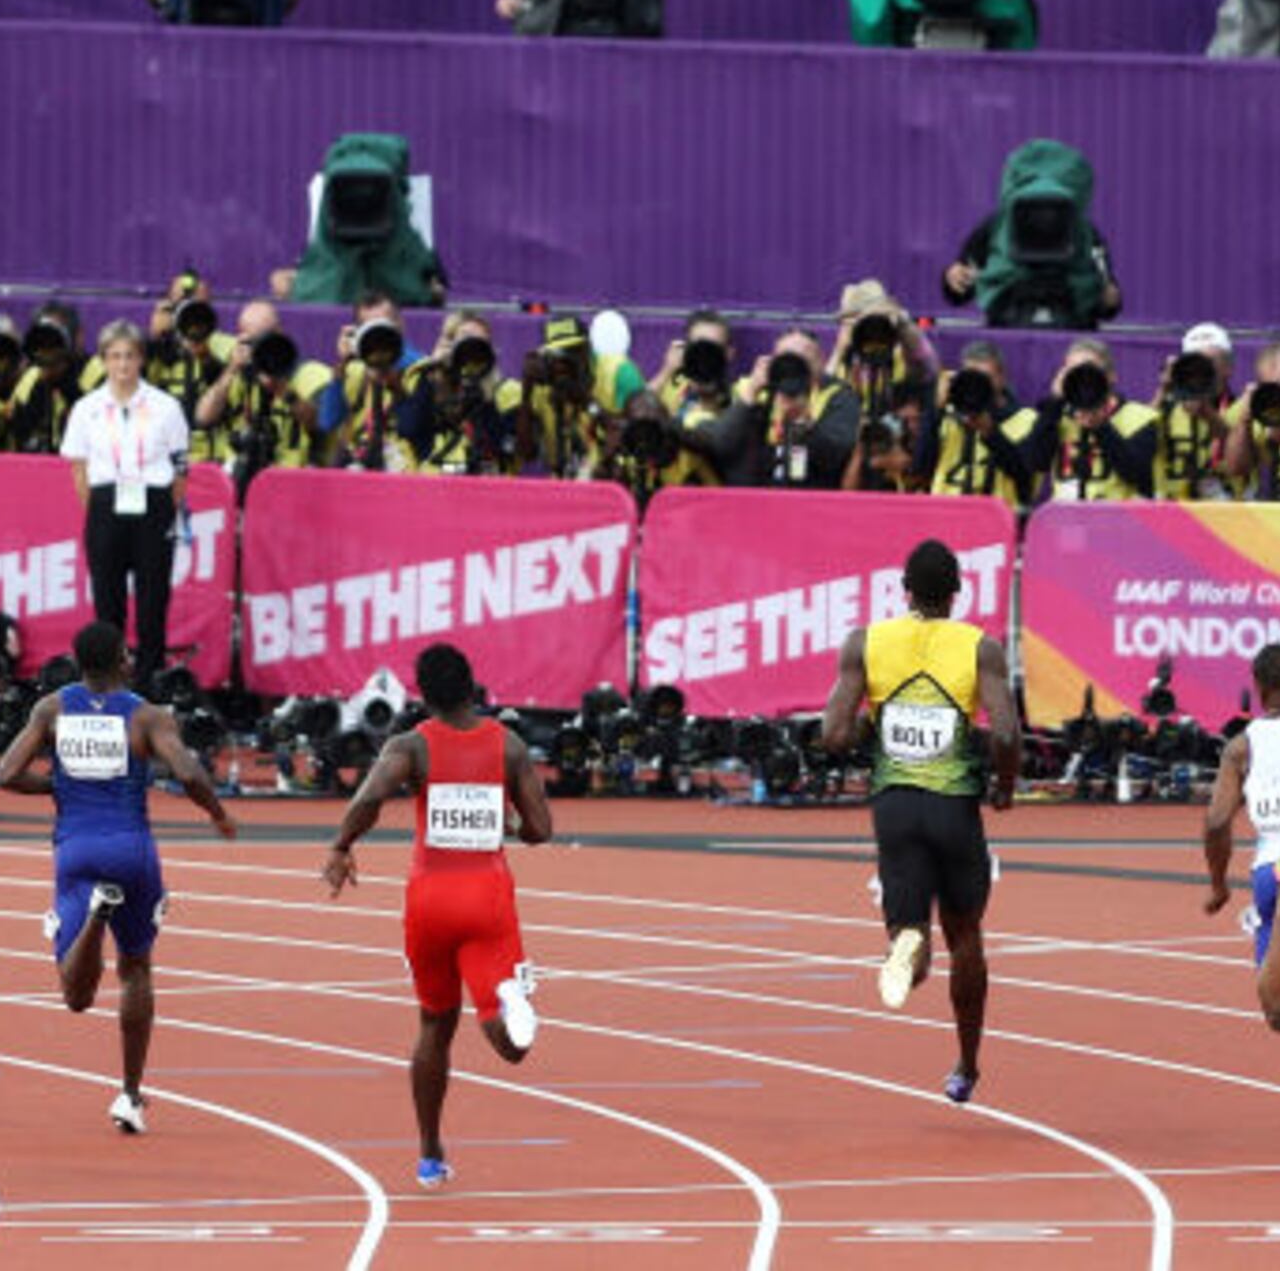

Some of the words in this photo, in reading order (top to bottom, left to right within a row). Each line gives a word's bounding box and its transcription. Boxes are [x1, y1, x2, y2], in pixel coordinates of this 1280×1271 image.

[249, 585, 328, 666] BE
[333, 558, 454, 650] THE
[462, 522, 629, 625] NEXT
[1116, 580, 1182, 605] IAAF
[1188, 581, 1251, 605] World
[645, 602, 748, 686] SEE
[753, 575, 862, 665] THE
[891, 724, 943, 749] BOLT
[431, 808, 498, 830] FISHER
